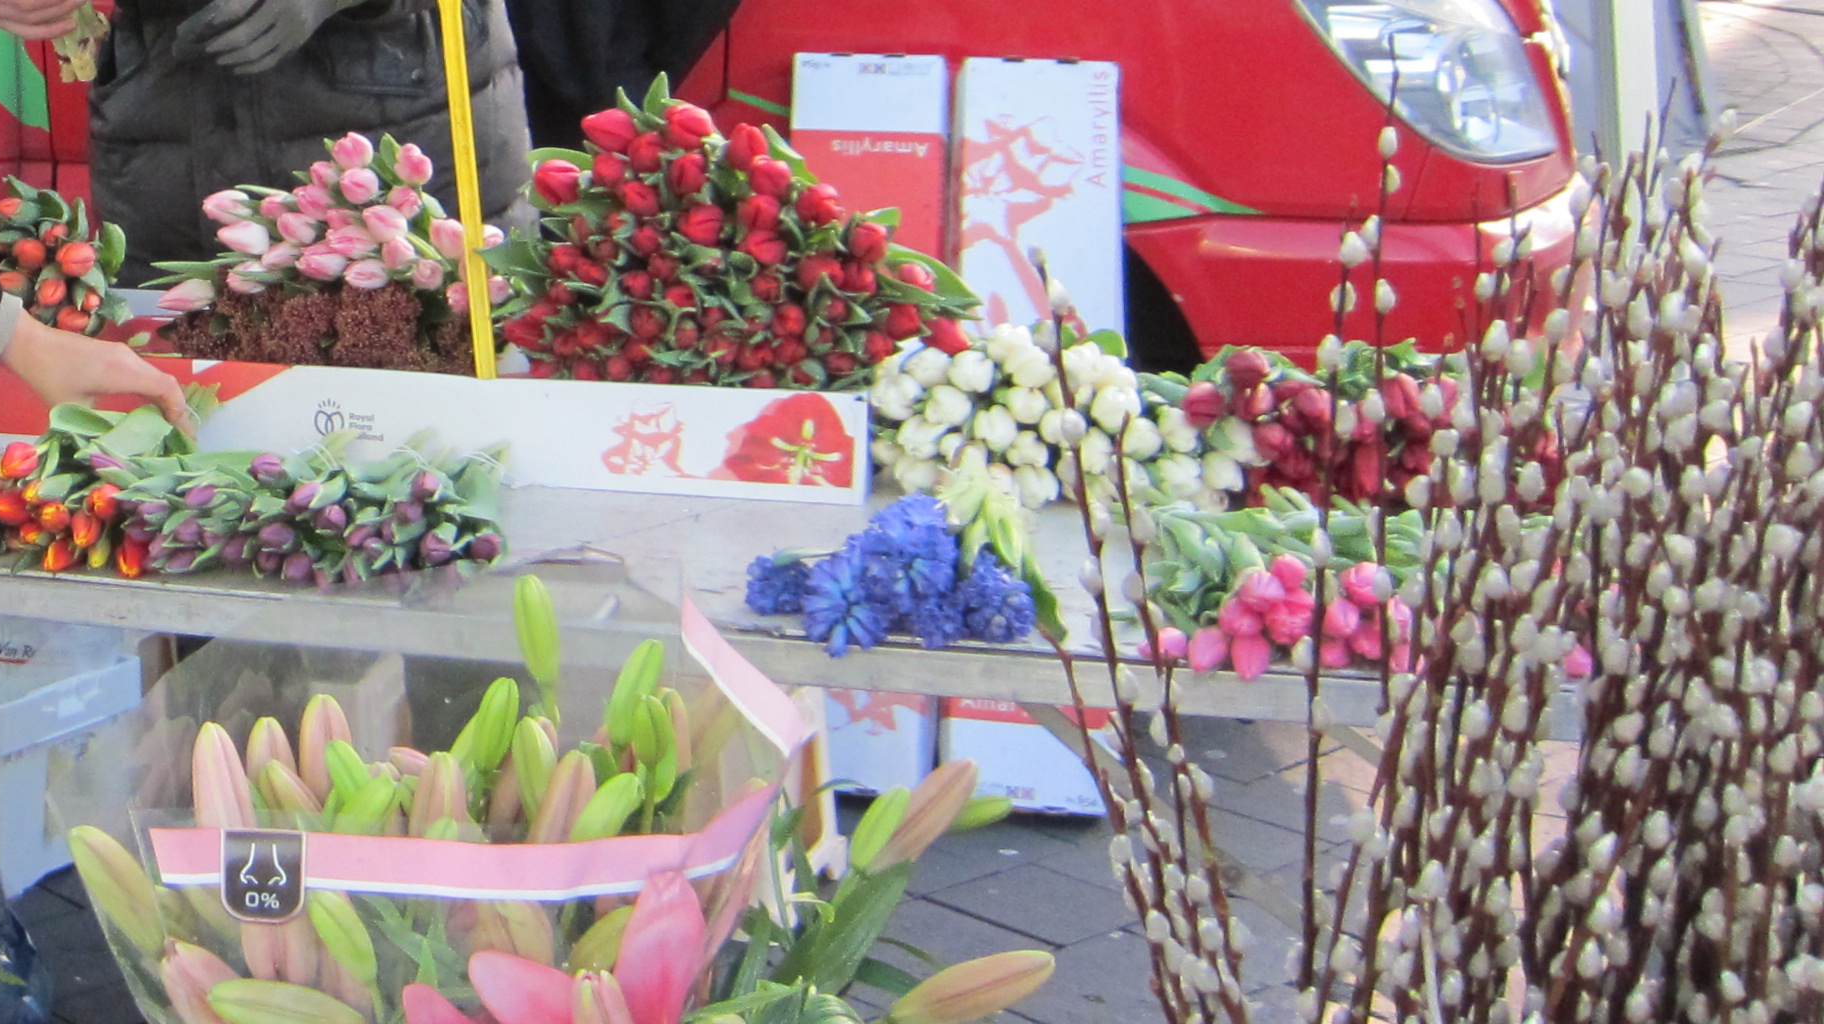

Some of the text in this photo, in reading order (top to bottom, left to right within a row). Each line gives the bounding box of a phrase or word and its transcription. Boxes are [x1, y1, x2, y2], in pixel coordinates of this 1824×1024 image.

[1087, 70, 1112, 187] Amaryllis
[832, 137, 929, 157] Amaryllis
[349, 413, 375, 422] Royal
[245, 891, 280, 909] 0%
